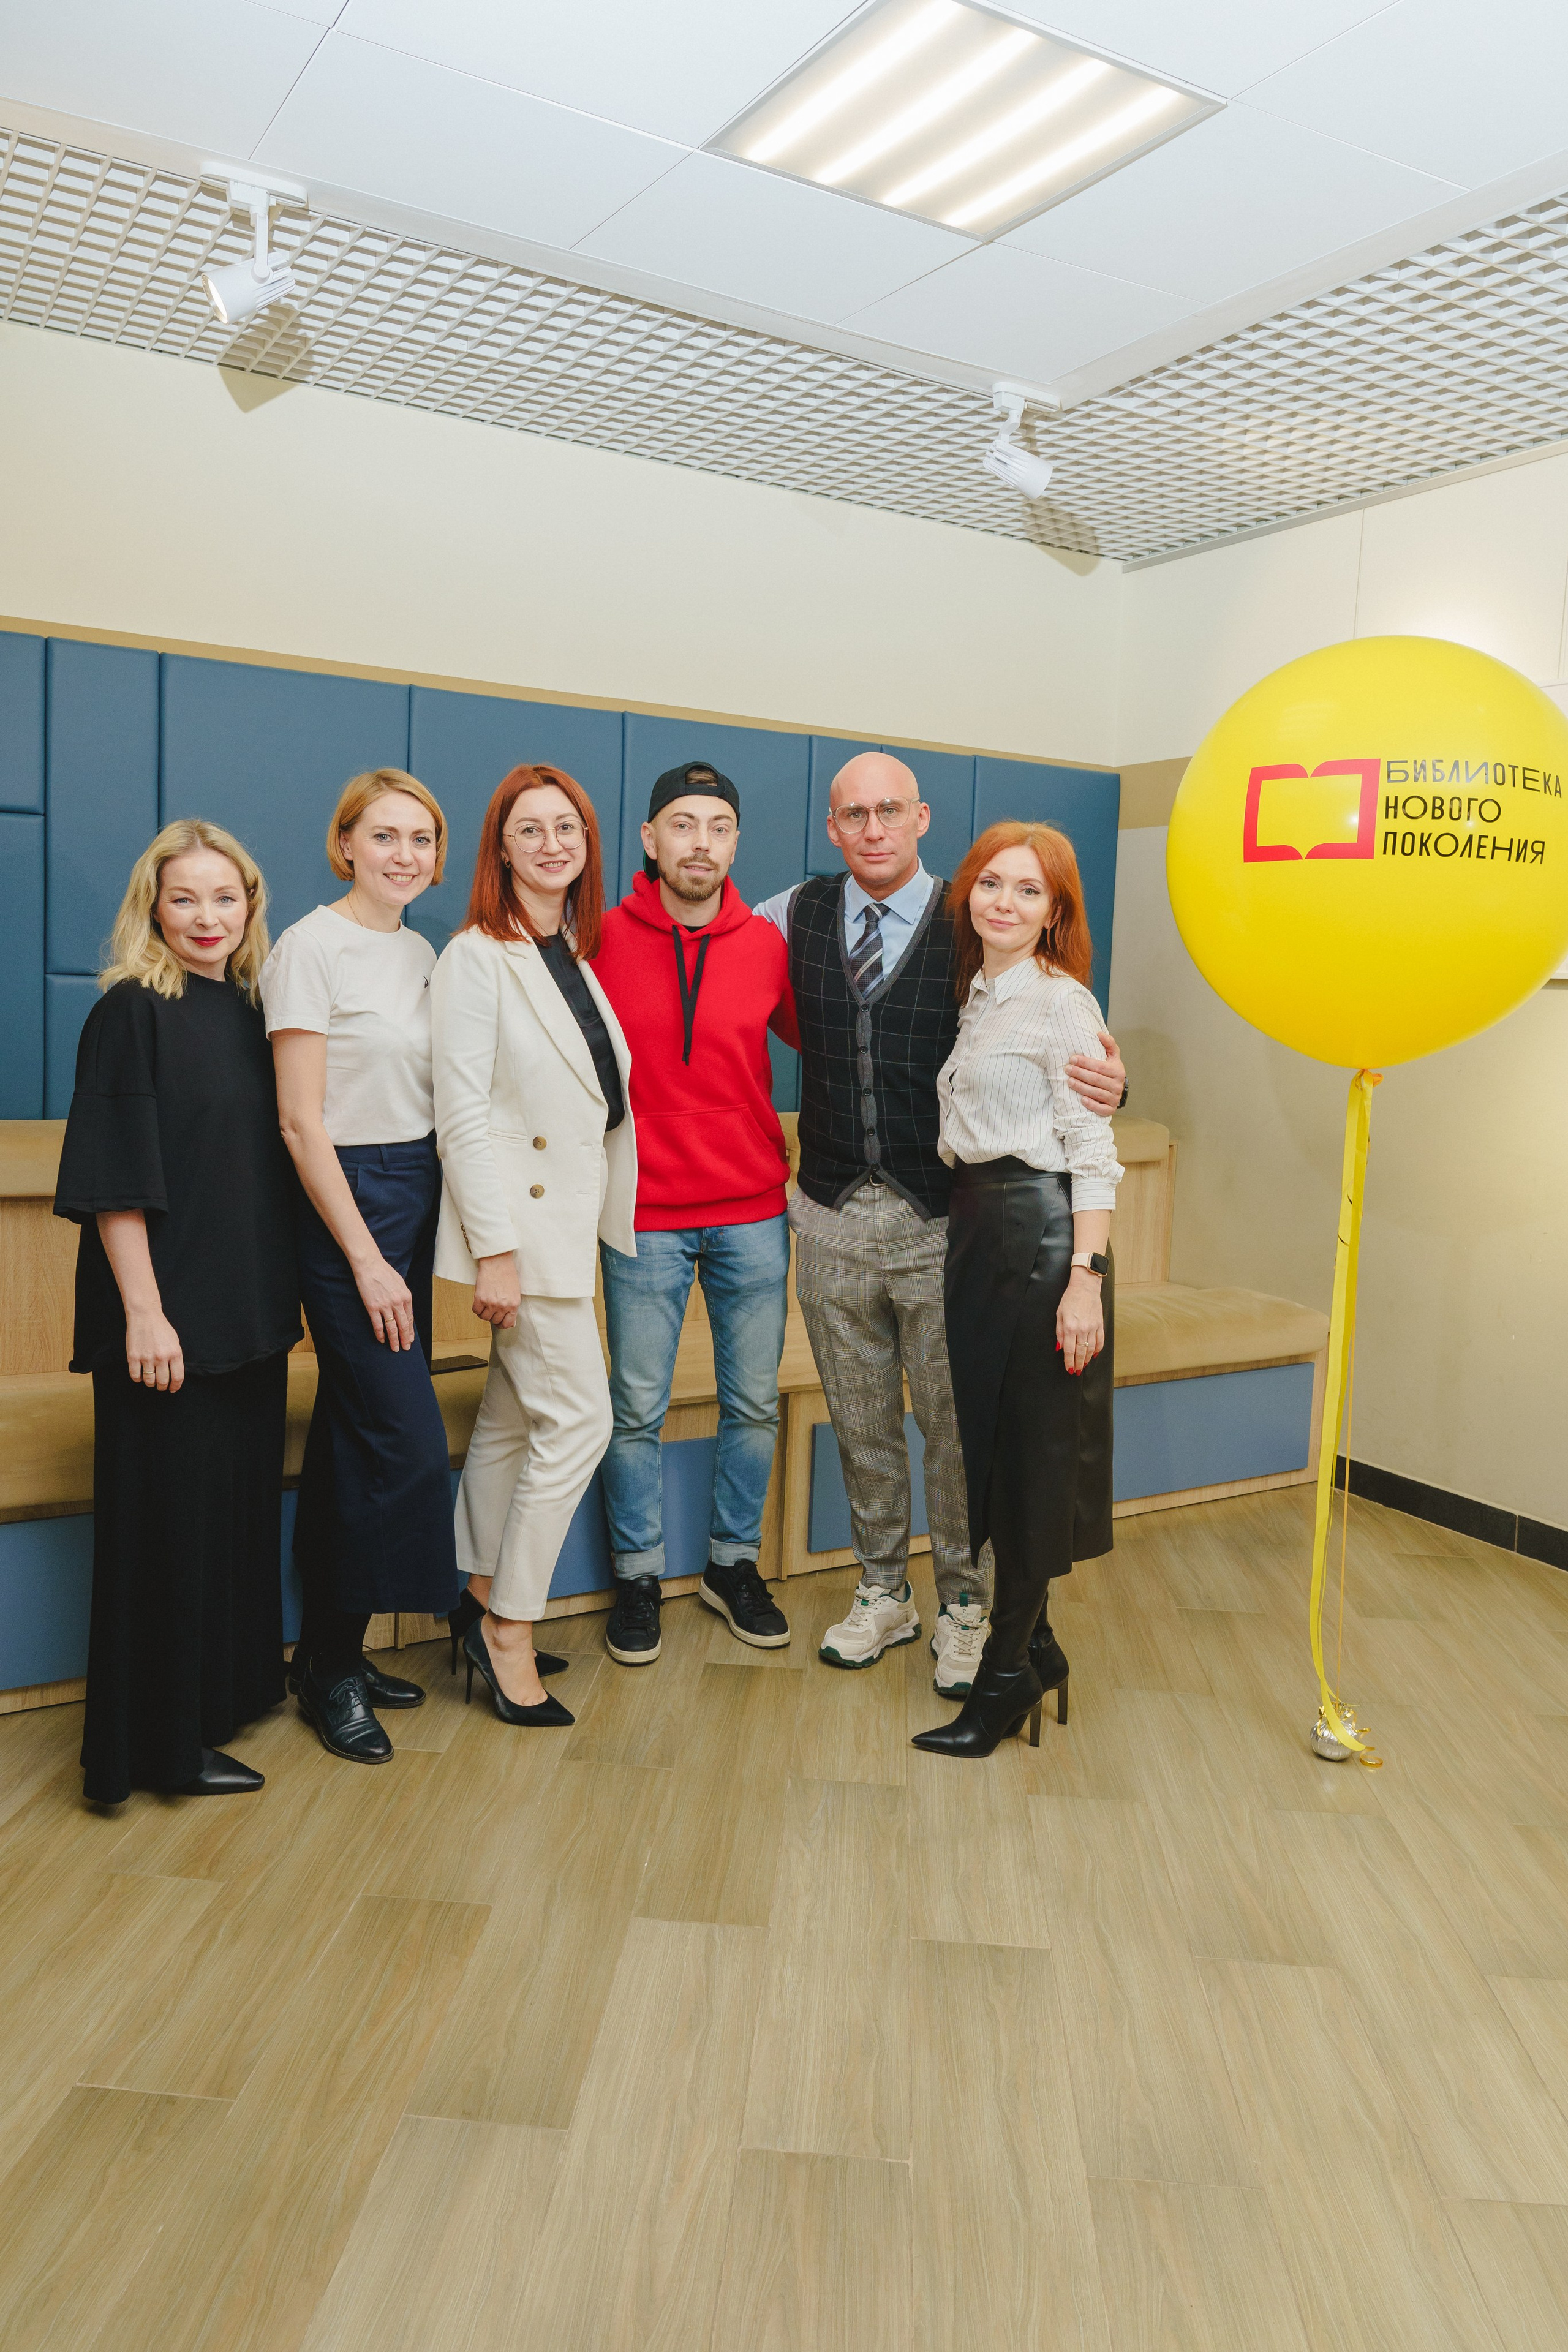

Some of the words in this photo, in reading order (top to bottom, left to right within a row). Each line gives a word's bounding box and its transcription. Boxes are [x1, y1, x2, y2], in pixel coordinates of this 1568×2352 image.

[1387, 760, 1562, 798] БИБЛИОТЕКА
[1384, 796, 1501, 823] НОВОГО
[1382, 832, 1545, 864] ПОКОЛЕНИЯ
